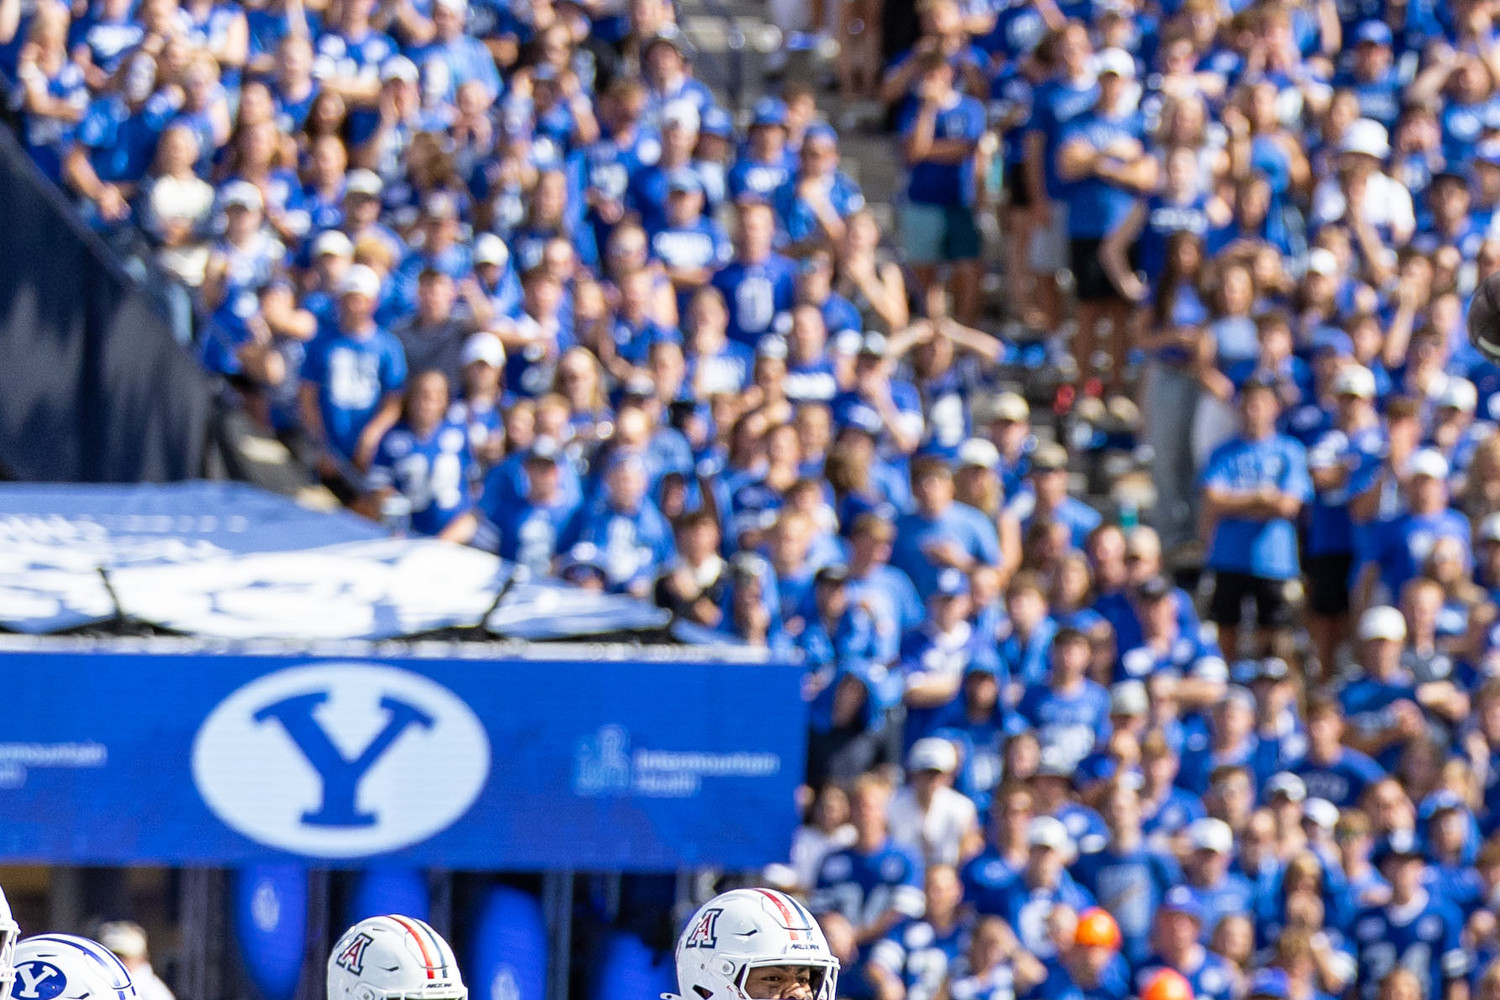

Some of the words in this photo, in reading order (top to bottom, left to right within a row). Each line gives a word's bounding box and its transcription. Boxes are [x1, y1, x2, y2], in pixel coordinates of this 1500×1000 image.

[252, 691, 435, 828] Y
[686, 908, 724, 949] A
[336, 932, 374, 976] A
[17, 964, 58, 998] Y
